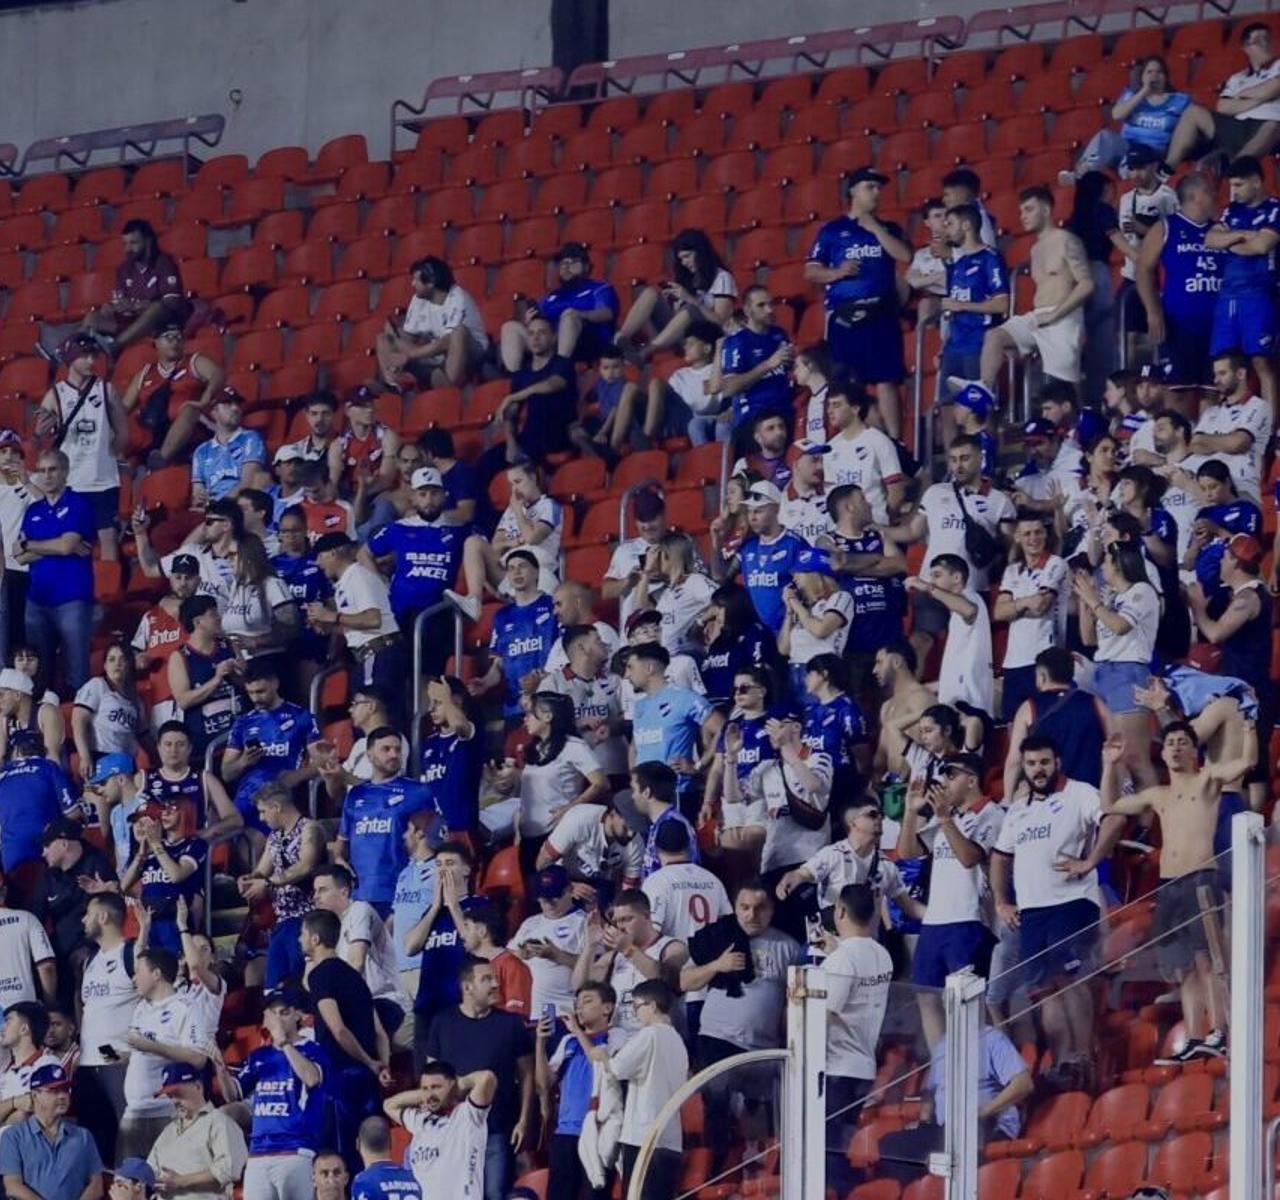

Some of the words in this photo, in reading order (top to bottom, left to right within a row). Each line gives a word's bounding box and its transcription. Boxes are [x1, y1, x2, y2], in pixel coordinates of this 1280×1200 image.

[1196, 256, 1218, 270] 45
[406, 551, 452, 561] macri
[406, 566, 449, 580] ANCEL
[747, 570, 779, 588] antel
[507, 635, 544, 656] antel
[356, 816, 393, 834] antel
